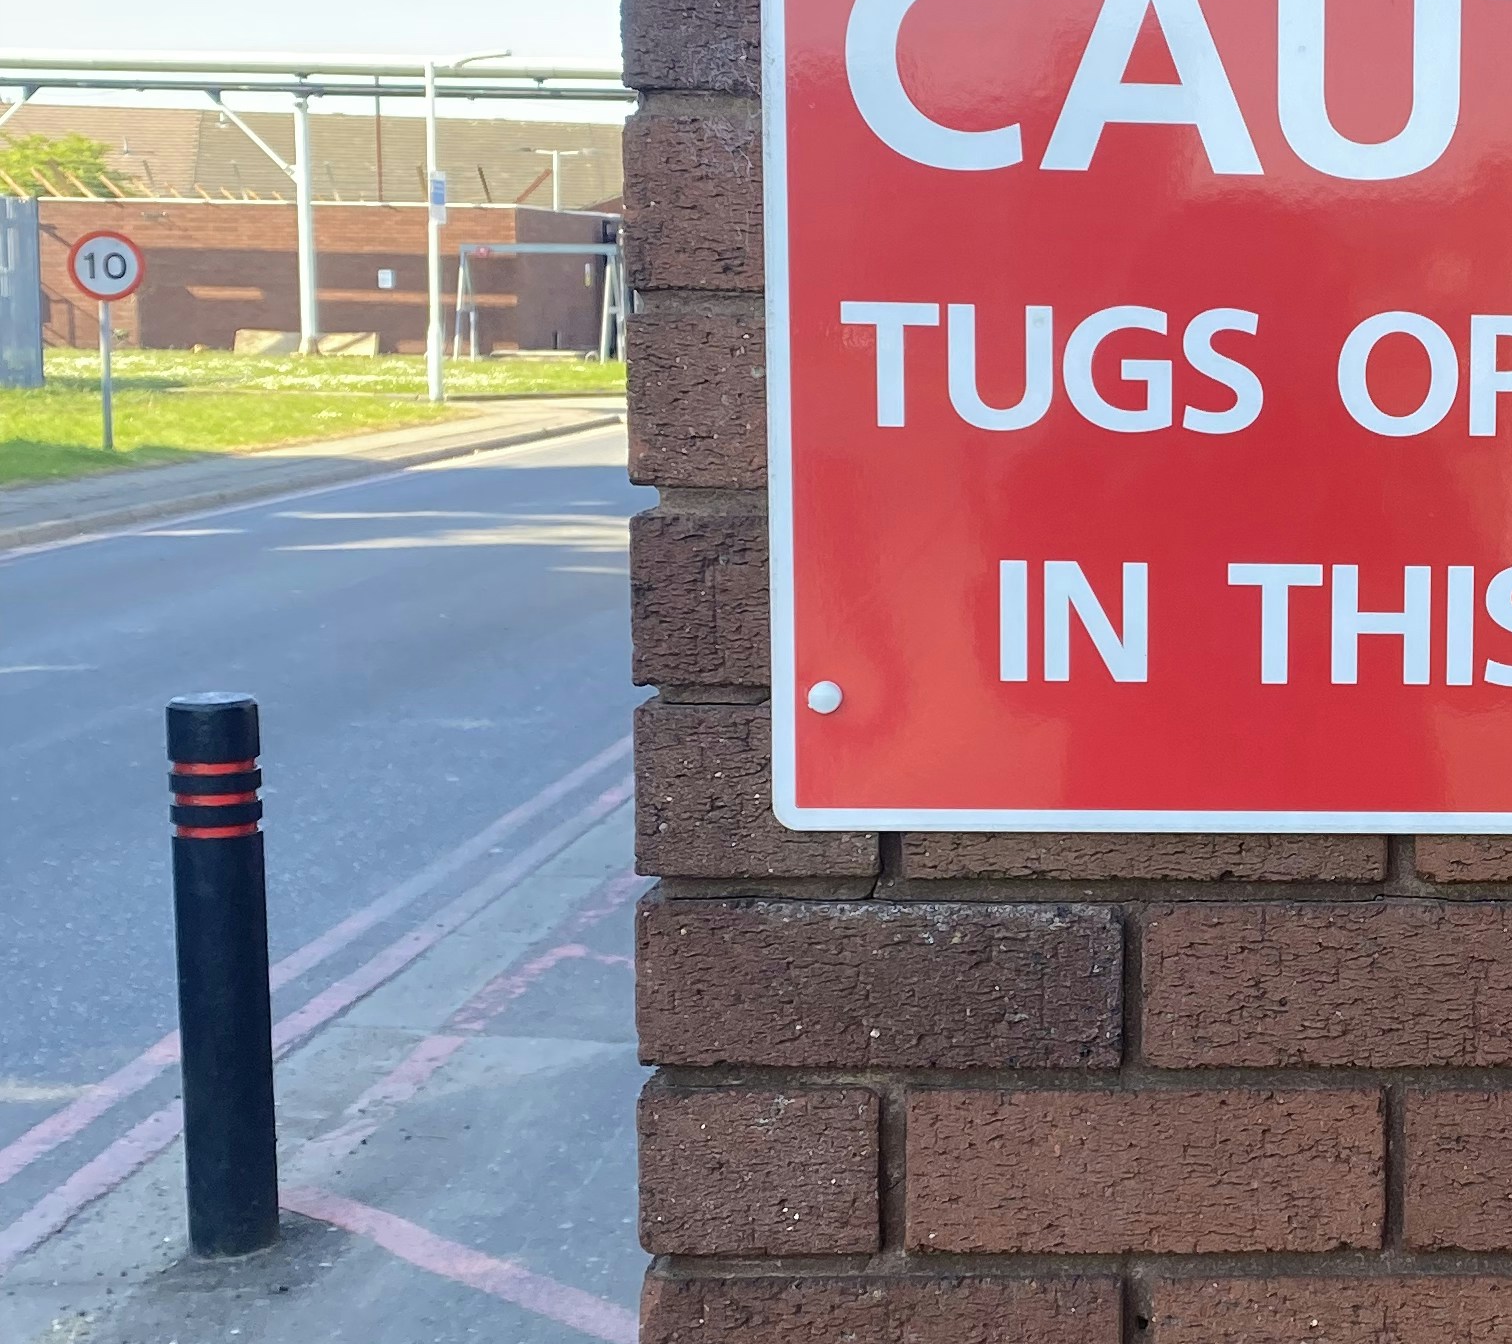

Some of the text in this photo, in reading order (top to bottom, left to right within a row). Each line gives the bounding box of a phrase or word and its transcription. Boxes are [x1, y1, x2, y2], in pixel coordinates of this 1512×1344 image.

[83, 252, 127, 280] 10
[841, 301, 1263, 434] TUGS
[1000, 560, 1148, 682] IN
